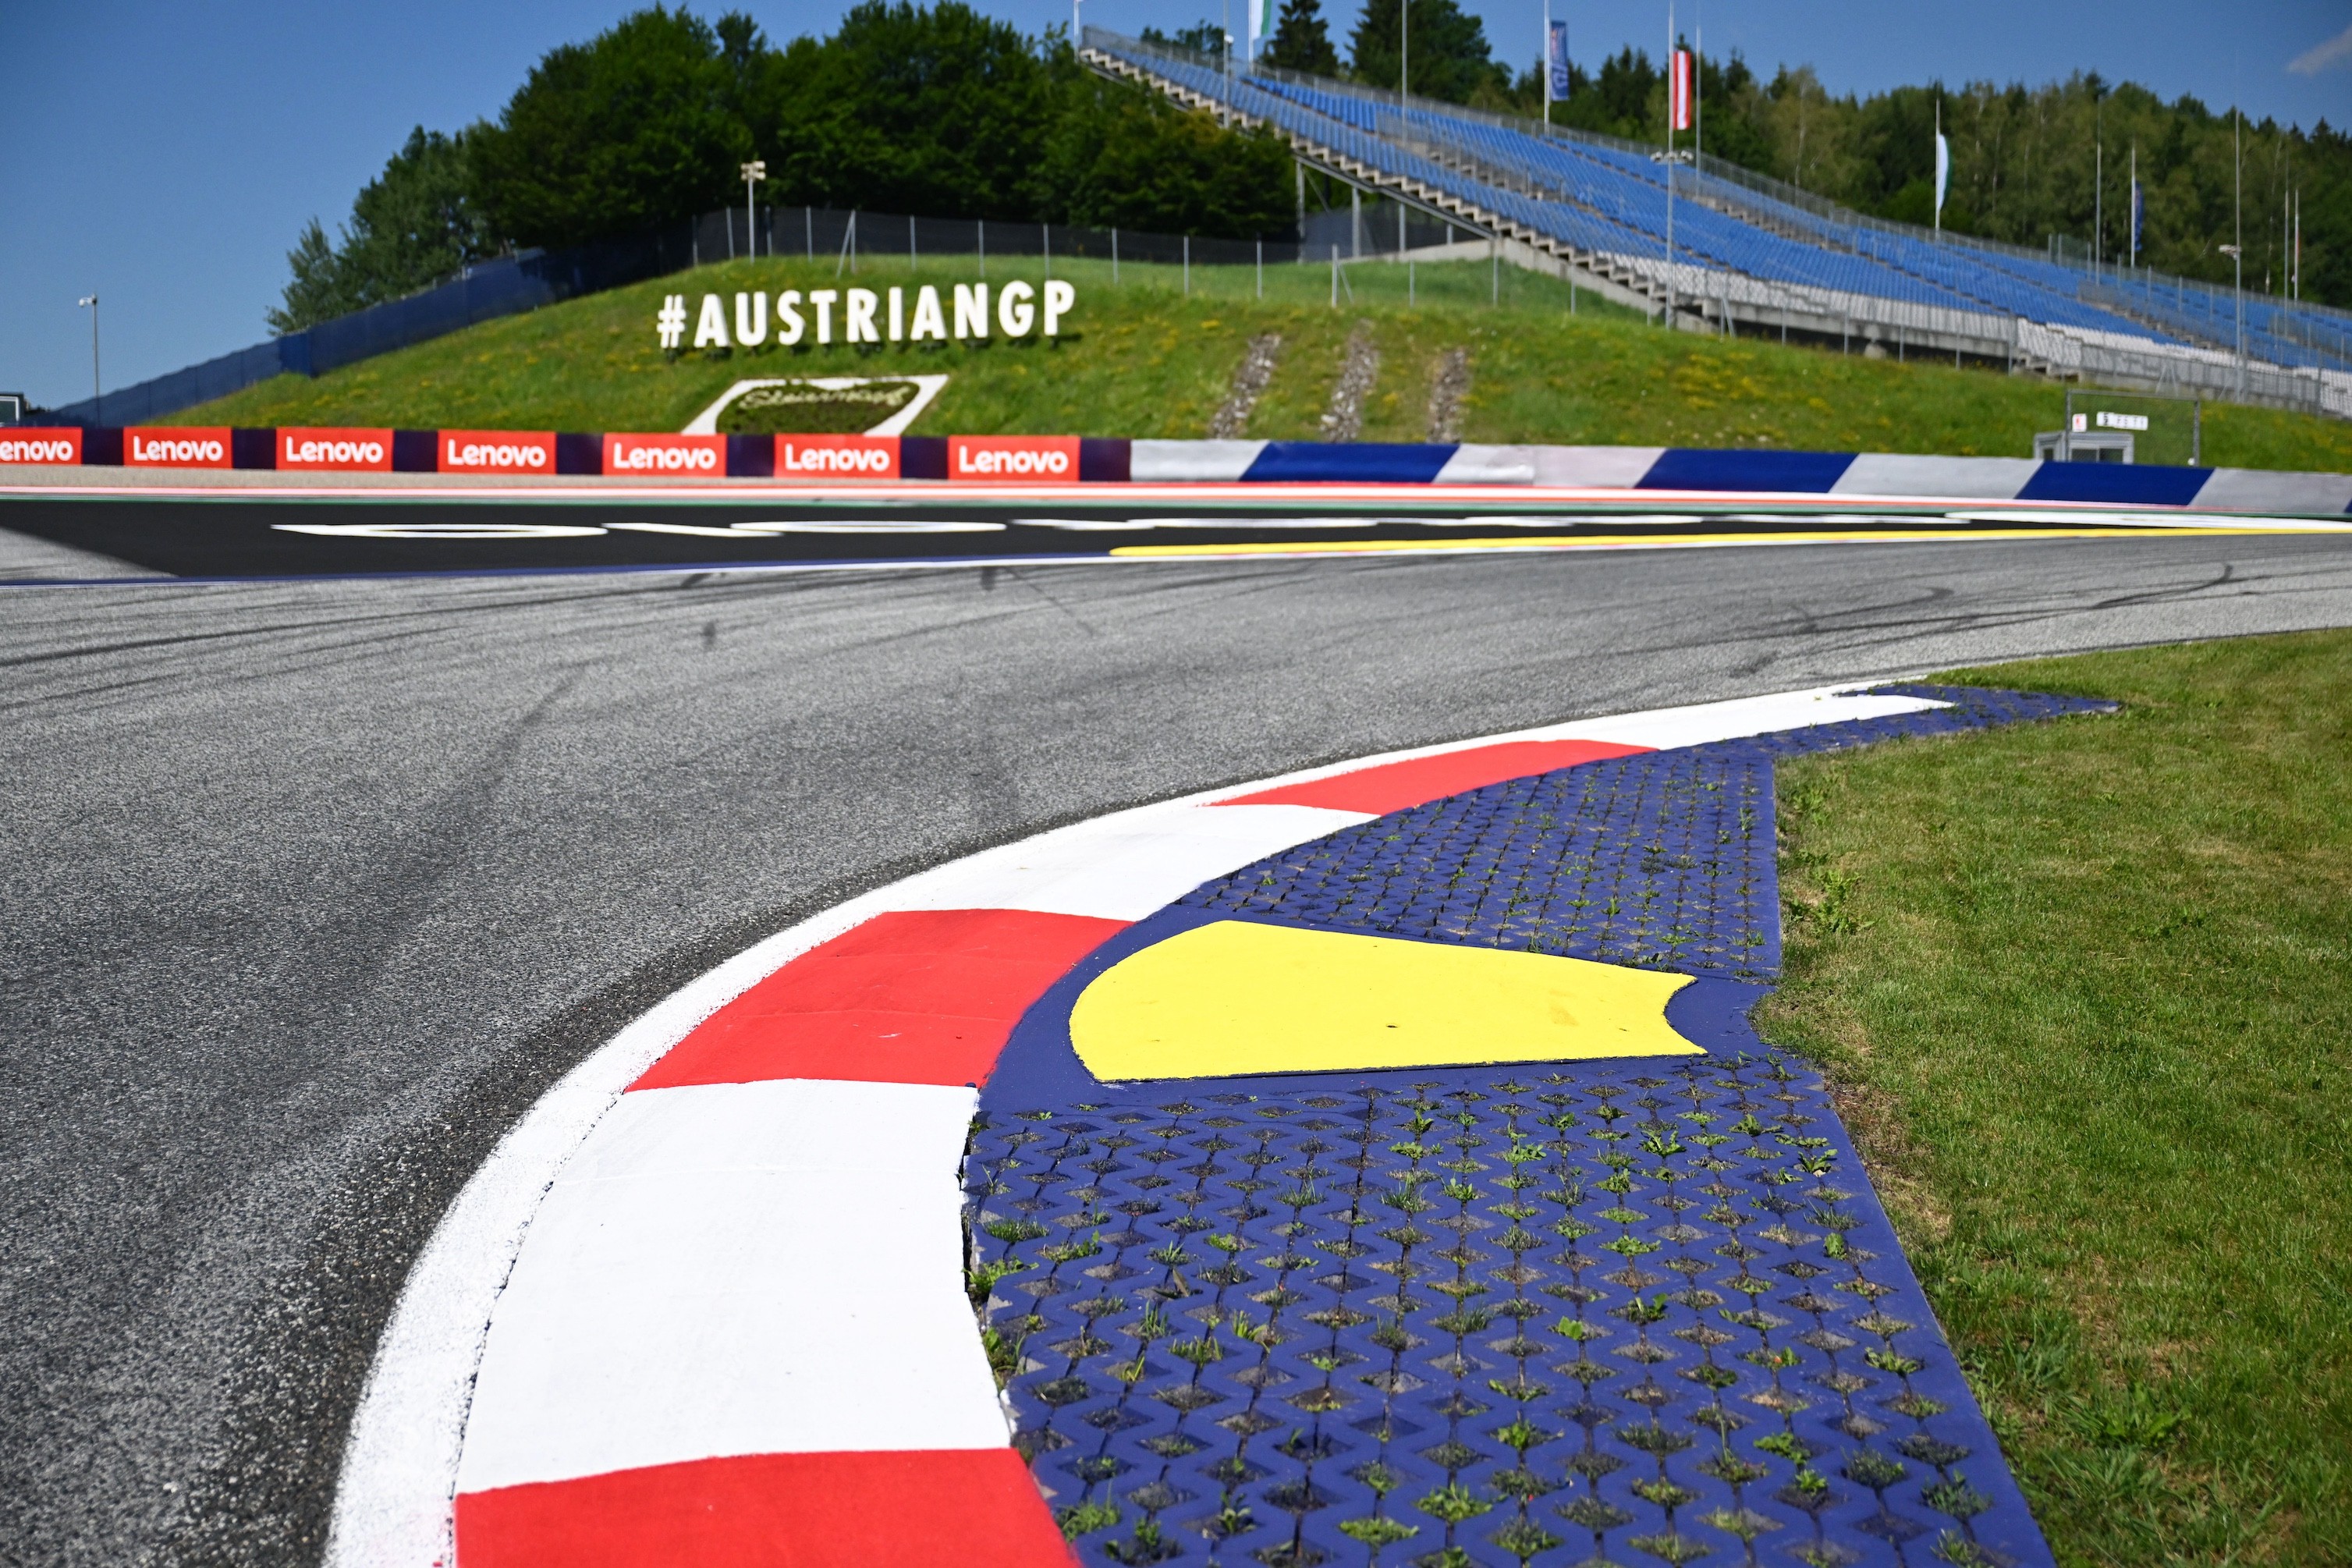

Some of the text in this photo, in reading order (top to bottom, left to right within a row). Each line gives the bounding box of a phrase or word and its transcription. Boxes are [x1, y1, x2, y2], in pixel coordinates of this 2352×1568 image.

[656, 279, 1076, 349] #AUSTRIANGP
[0, 440, 73, 461] enovo
[133, 435, 223, 461] Lenovo
[286, 436, 384, 463] Lenovo
[447, 439, 546, 467] Lenovo
[612, 442, 717, 470] Lenovo
[784, 443, 890, 472] Lenovo
[958, 445, 1069, 474] Lenovo
